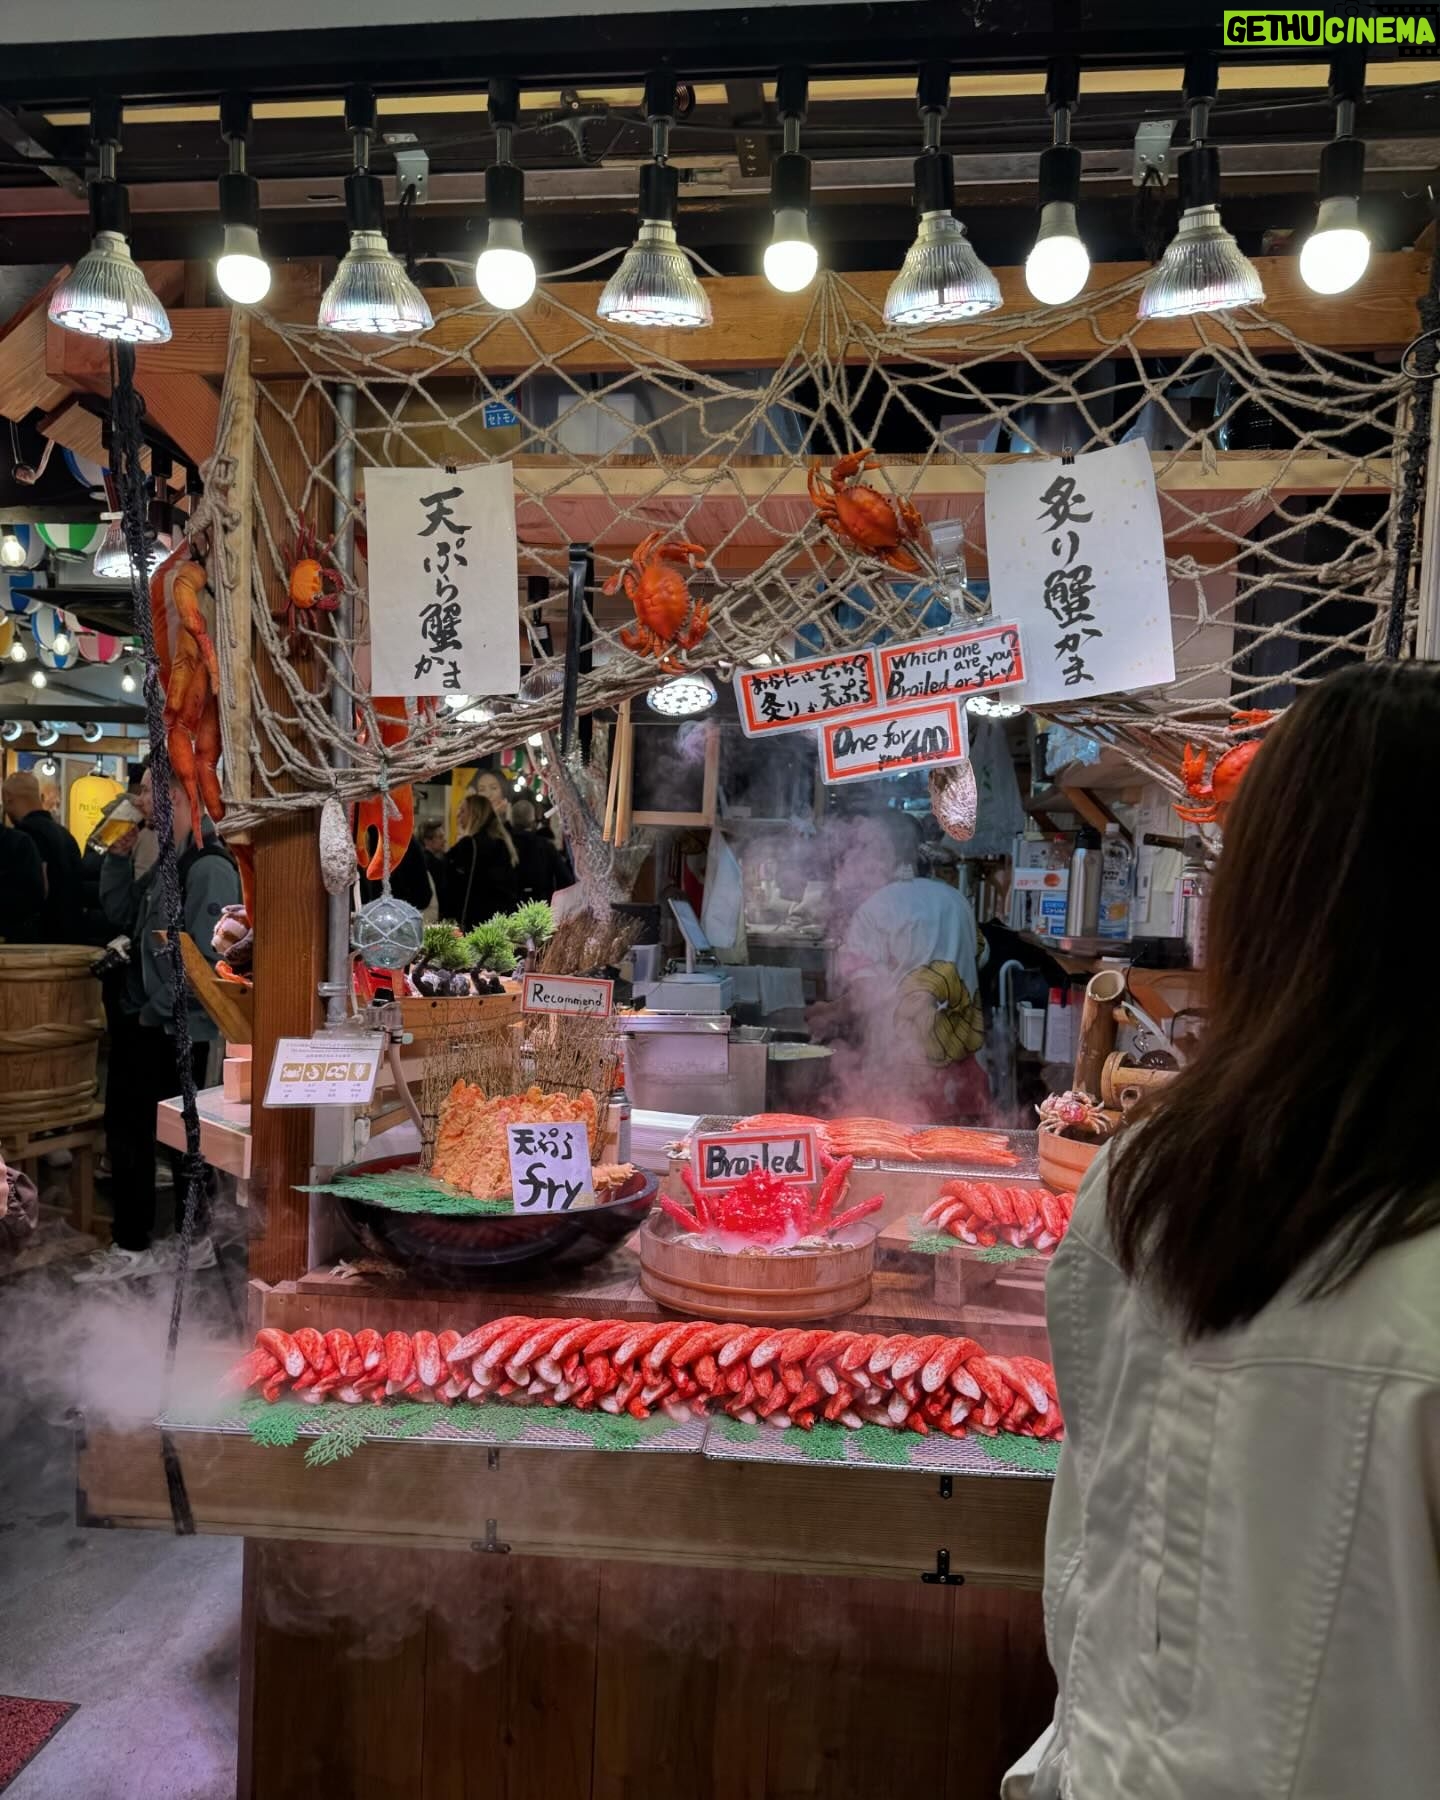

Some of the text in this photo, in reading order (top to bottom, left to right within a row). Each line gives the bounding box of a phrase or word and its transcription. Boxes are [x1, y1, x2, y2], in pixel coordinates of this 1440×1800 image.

[414, 486, 473, 690] 天ぷら蟹かま
[1035, 475, 1104, 687] 炙り蟹かま
[890, 642, 982, 669] Which one
[954, 656, 981, 671] are
[886, 668, 951, 699] Broiled
[954, 676, 973, 689] or
[833, 725, 879, 759] One
[882, 720, 913, 749] for
[511, 1127, 574, 1161] 天ぷら
[706, 1140, 805, 1179] Broiled
